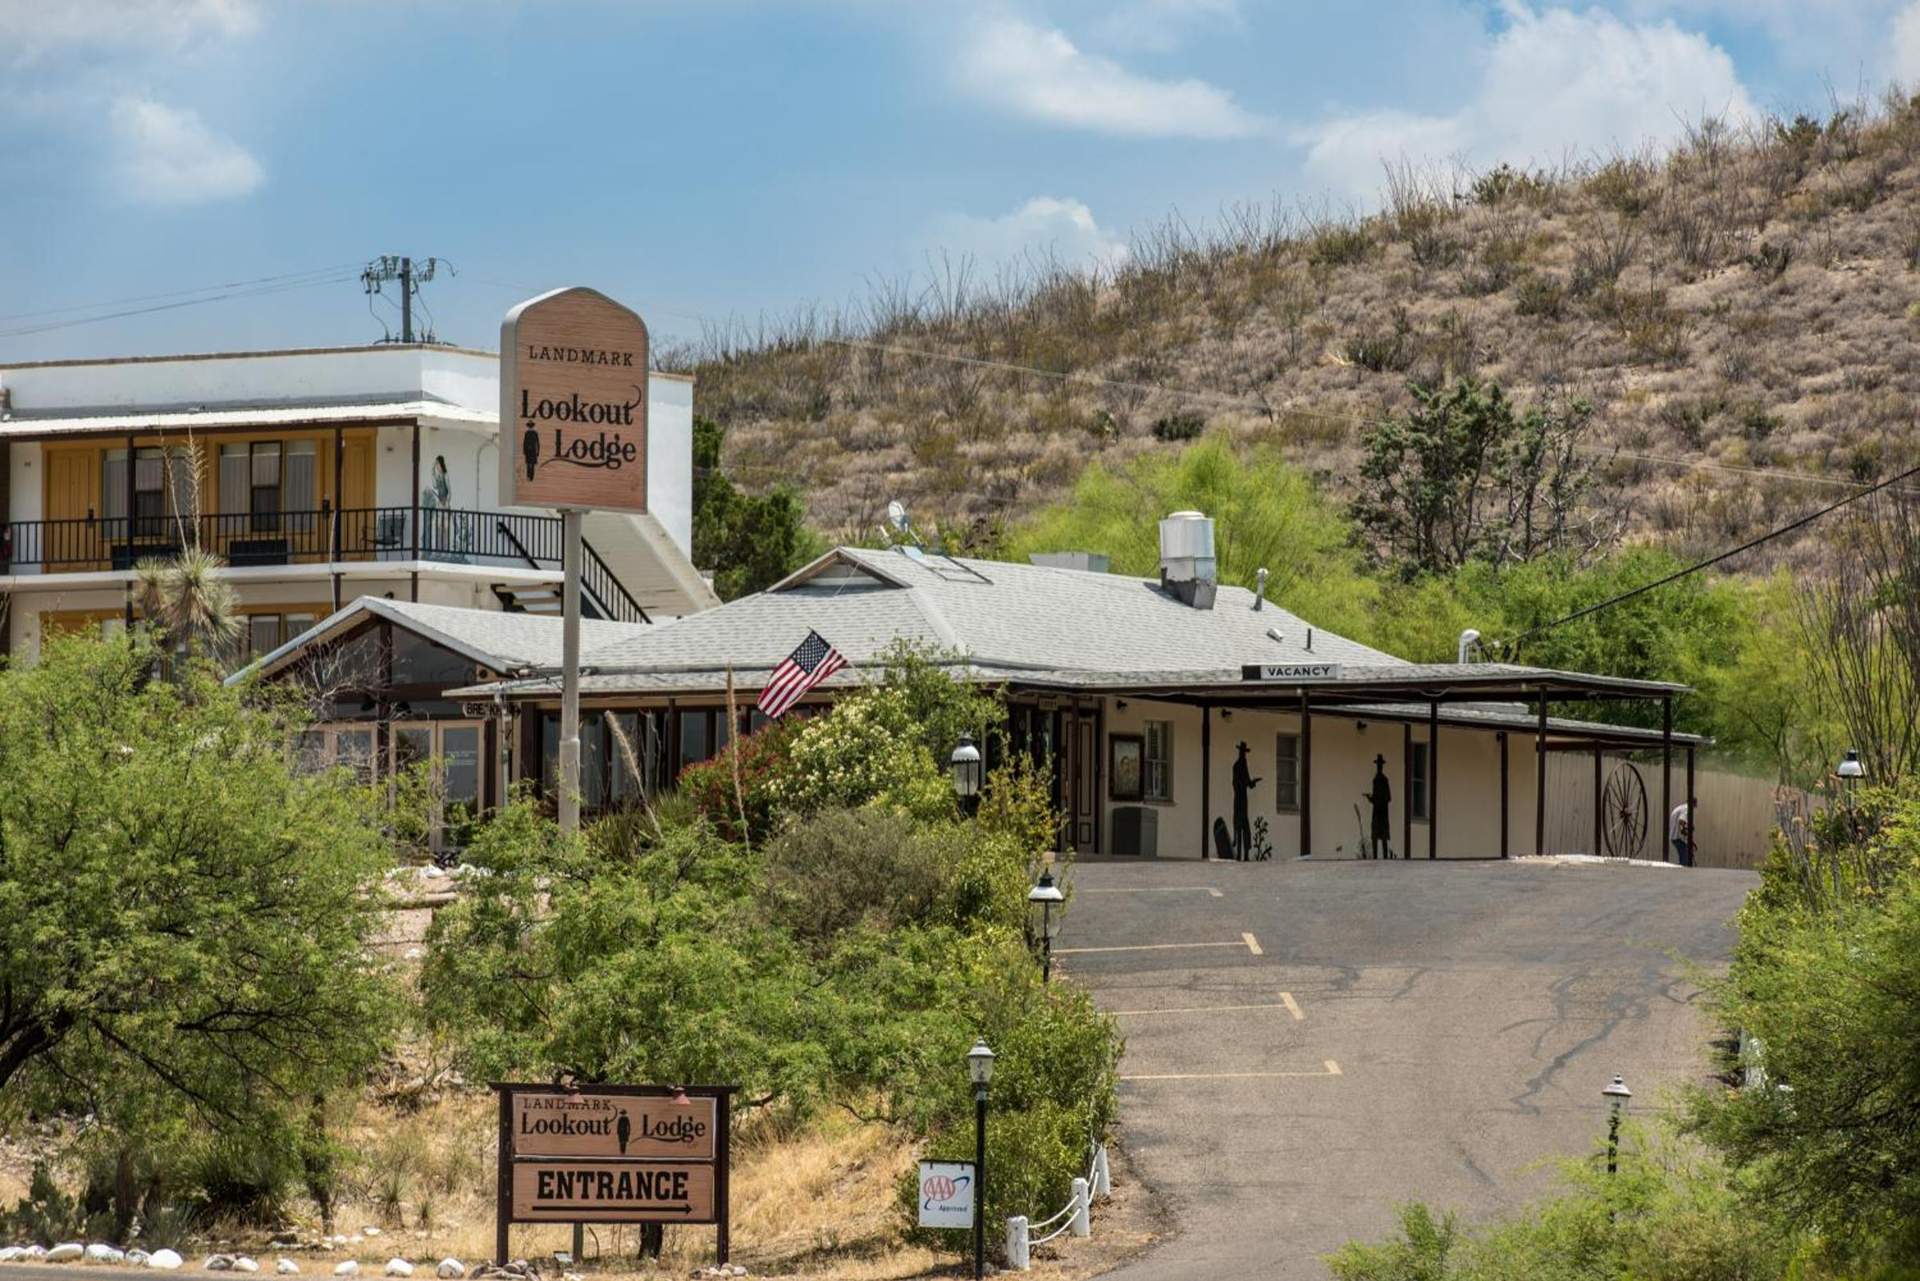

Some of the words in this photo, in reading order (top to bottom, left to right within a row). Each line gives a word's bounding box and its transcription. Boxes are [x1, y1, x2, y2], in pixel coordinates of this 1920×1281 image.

[529, 345, 633, 367] LANDMARK
[520, 385, 642, 425] Lookout
[541, 429, 637, 470] Lodge
[1268, 666, 1330, 676] VACANCY
[521, 1106, 618, 1135] Lookout
[632, 1114, 706, 1143] Lodge
[537, 1170, 689, 1200] ENTRANCE
